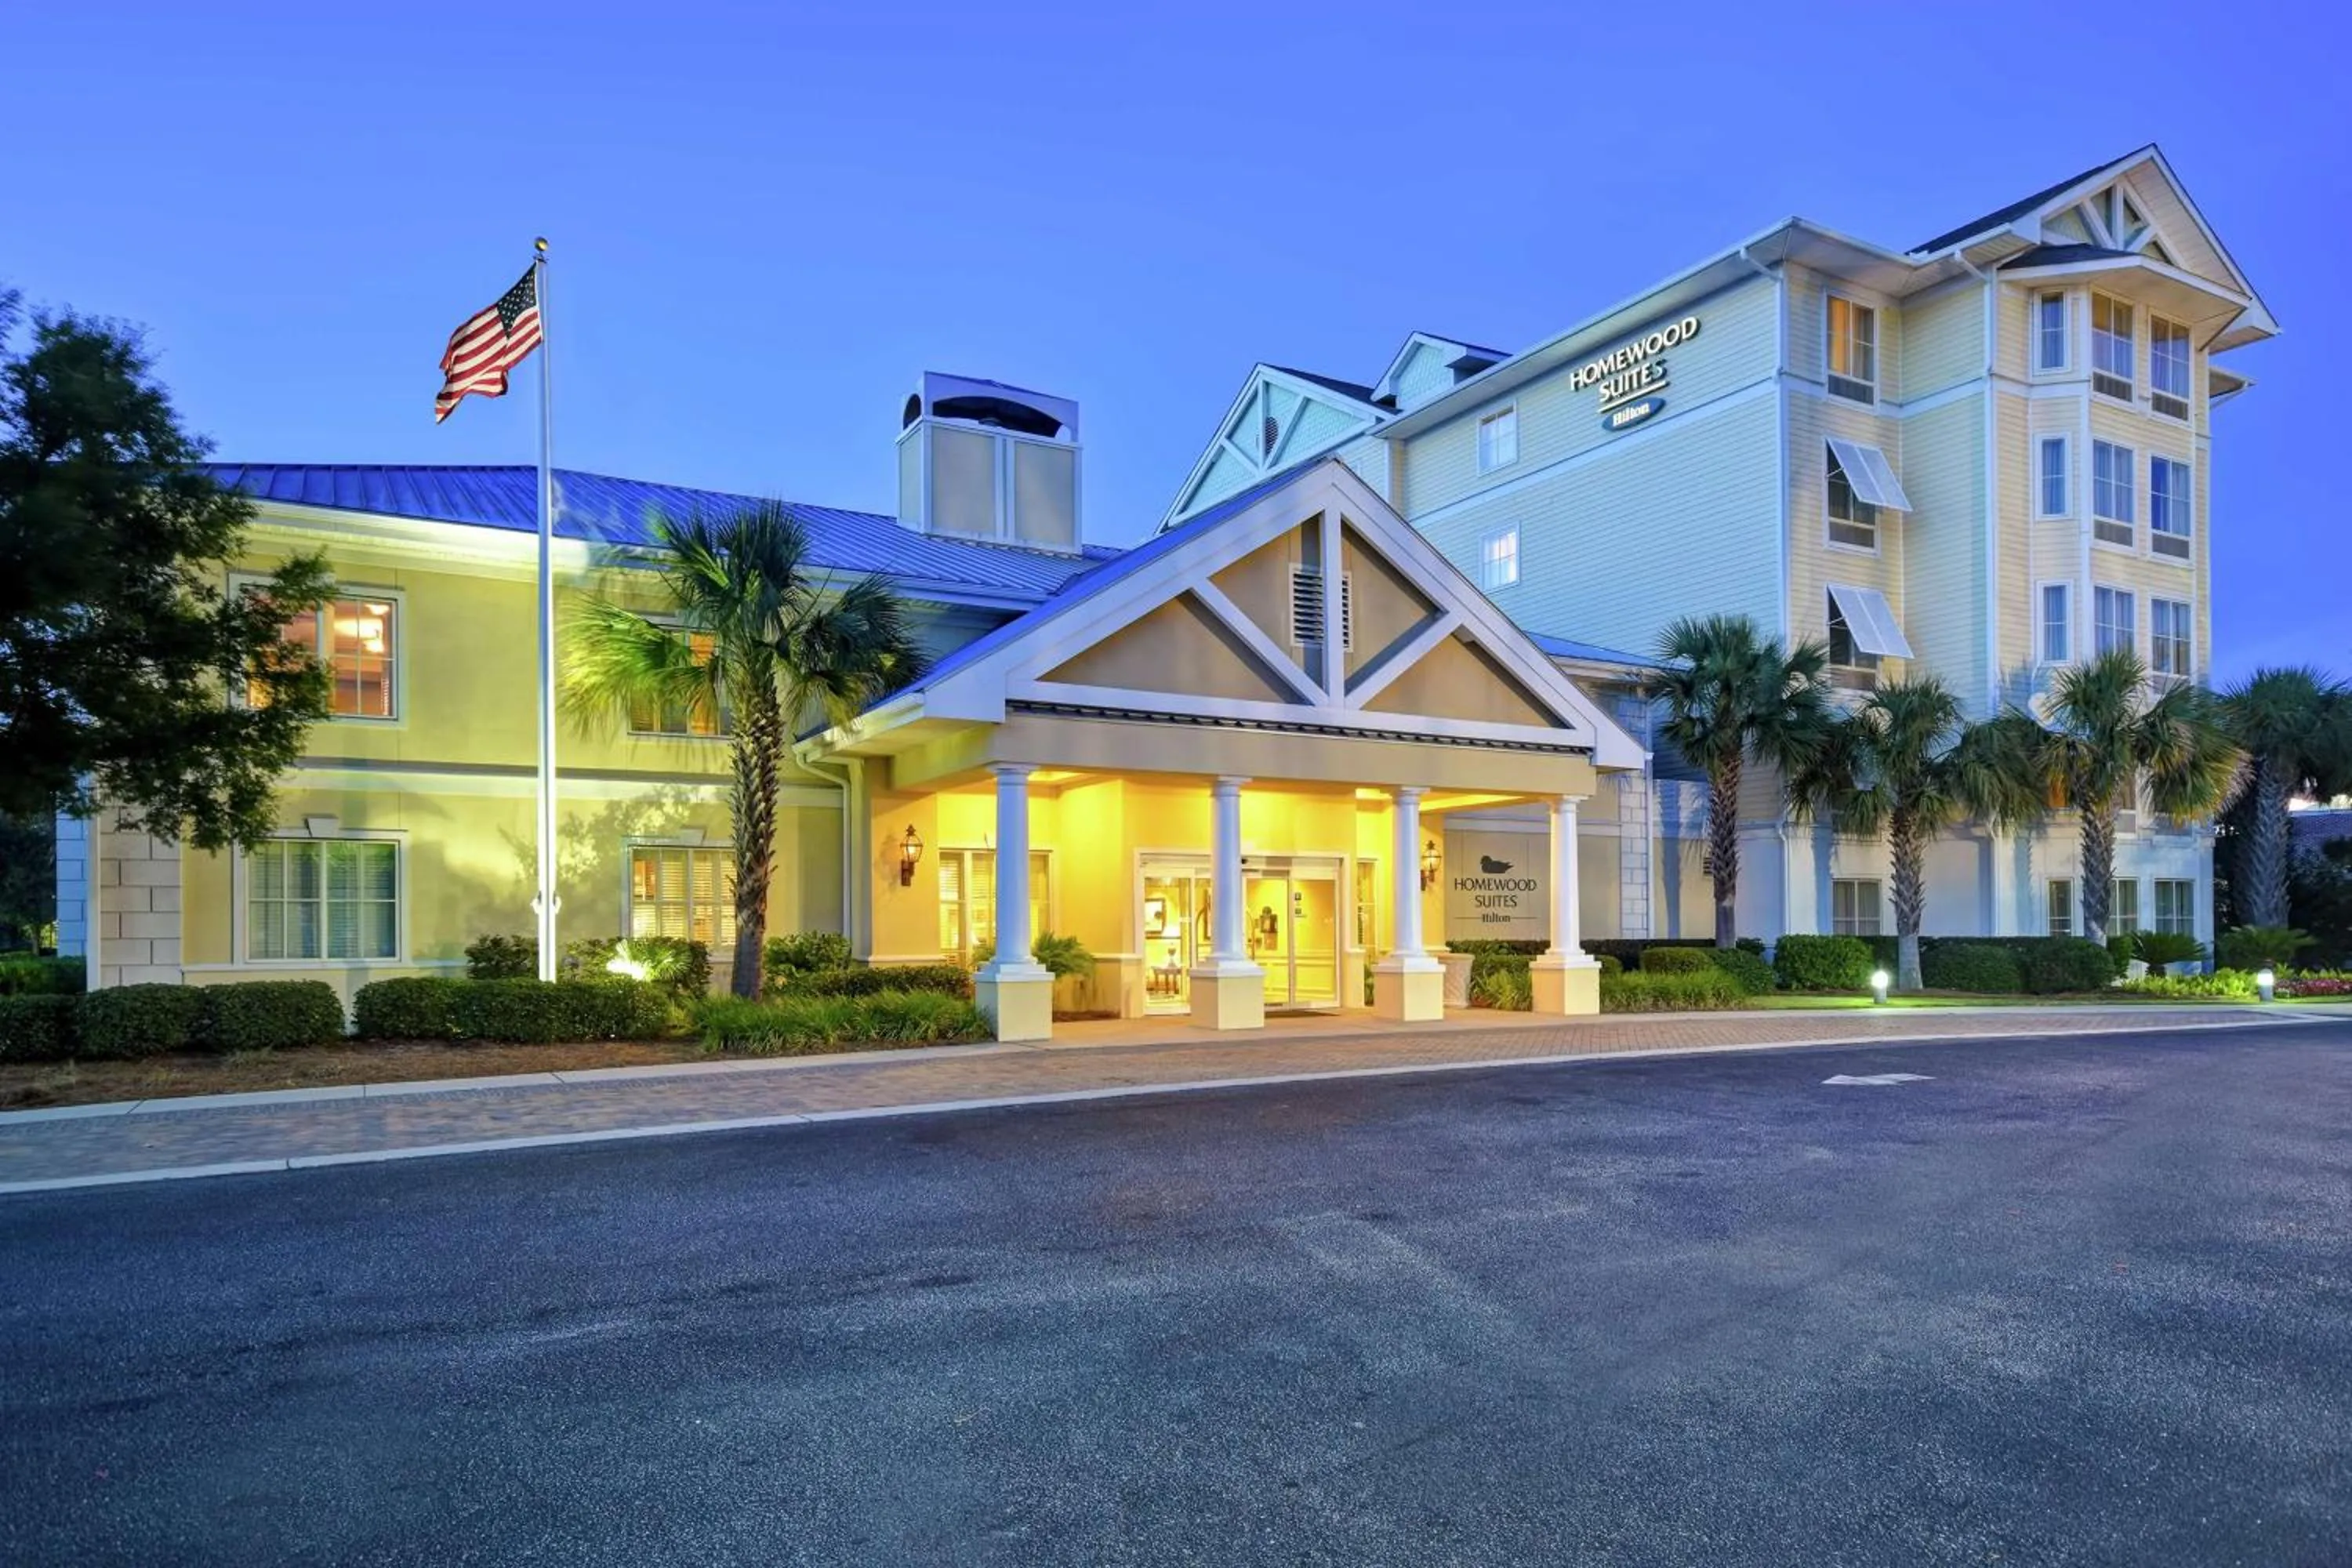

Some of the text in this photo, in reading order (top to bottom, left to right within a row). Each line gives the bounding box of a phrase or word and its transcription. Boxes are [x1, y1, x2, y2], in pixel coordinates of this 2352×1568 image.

[1570, 317, 1700, 391] HOMEWOOD
[1599, 359, 1667, 402] SUITES
[1613, 402, 1650, 426] Hilton
[1454, 877, 1537, 891] HOMEWOOD
[1475, 895, 1518, 908] SUITES
[1482, 912, 1511, 923] Hilton
